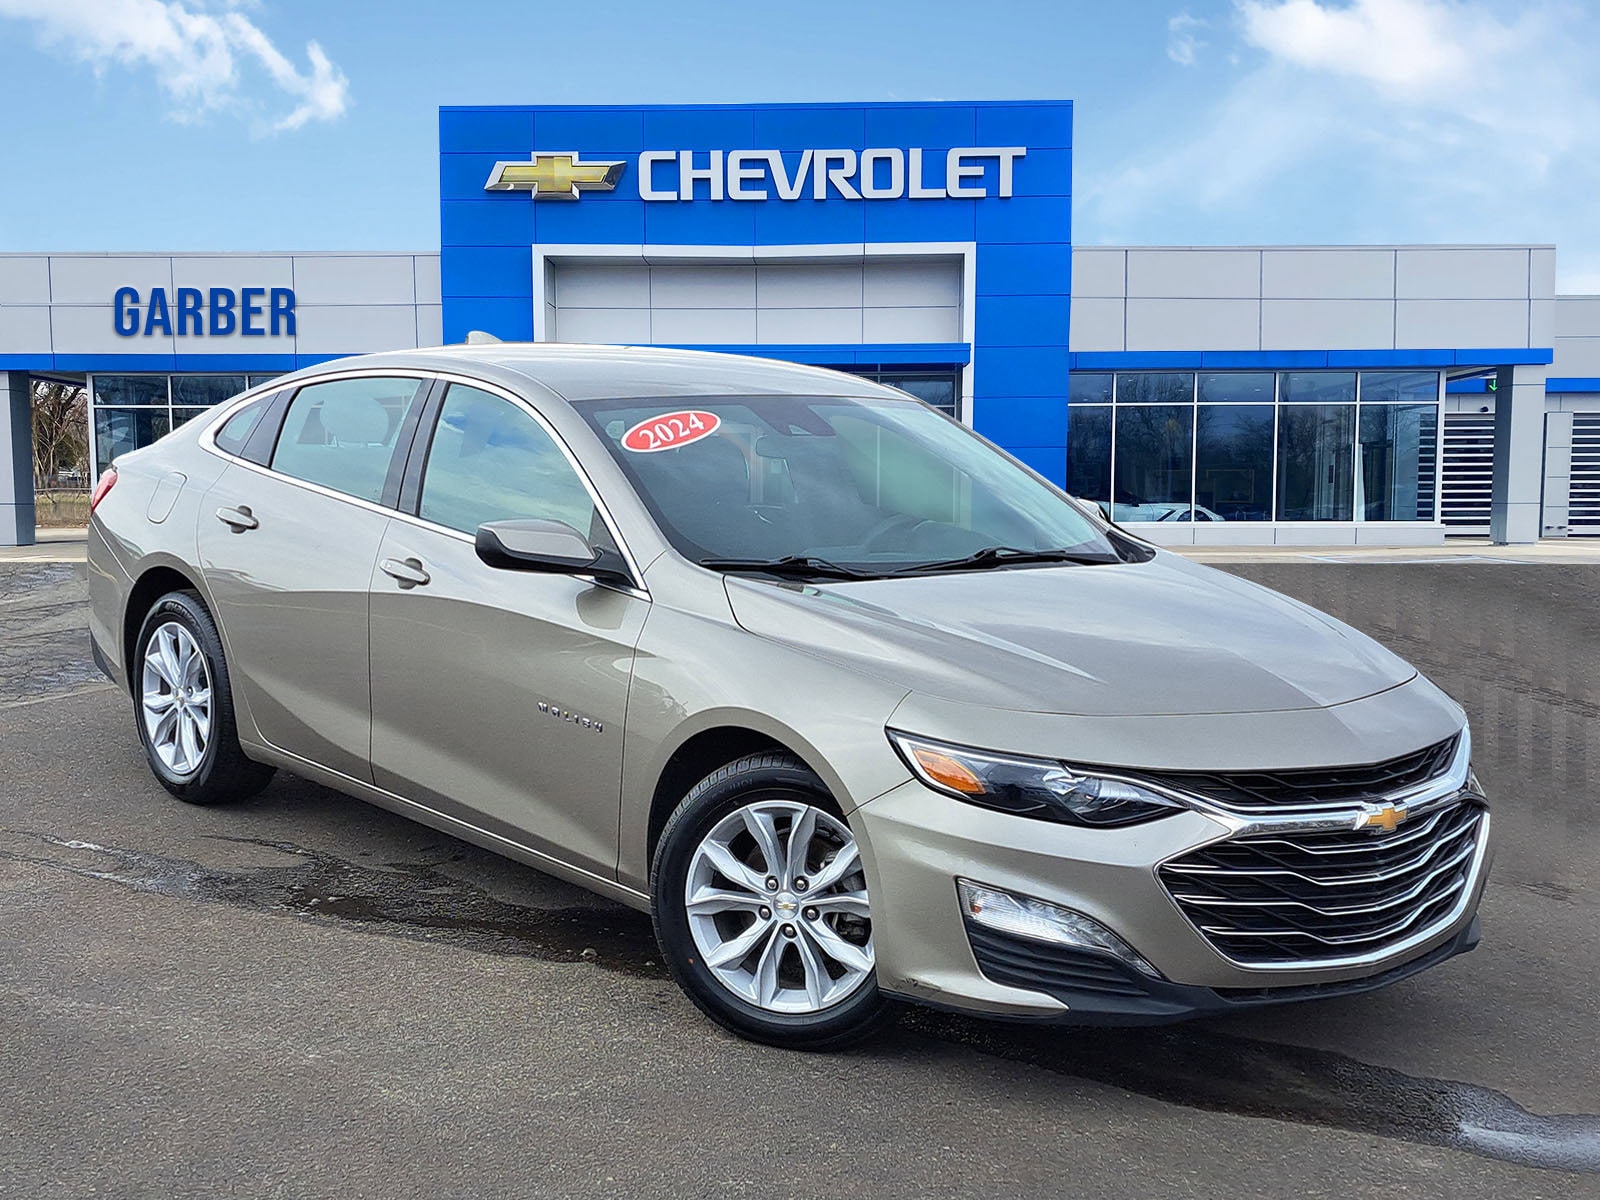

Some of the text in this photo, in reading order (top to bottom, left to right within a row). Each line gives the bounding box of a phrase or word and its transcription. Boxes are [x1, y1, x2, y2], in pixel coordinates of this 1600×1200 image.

[638, 147, 1026, 200] CHEVROLET
[114, 287, 297, 336] GARBER
[639, 412, 704, 449] 2024
